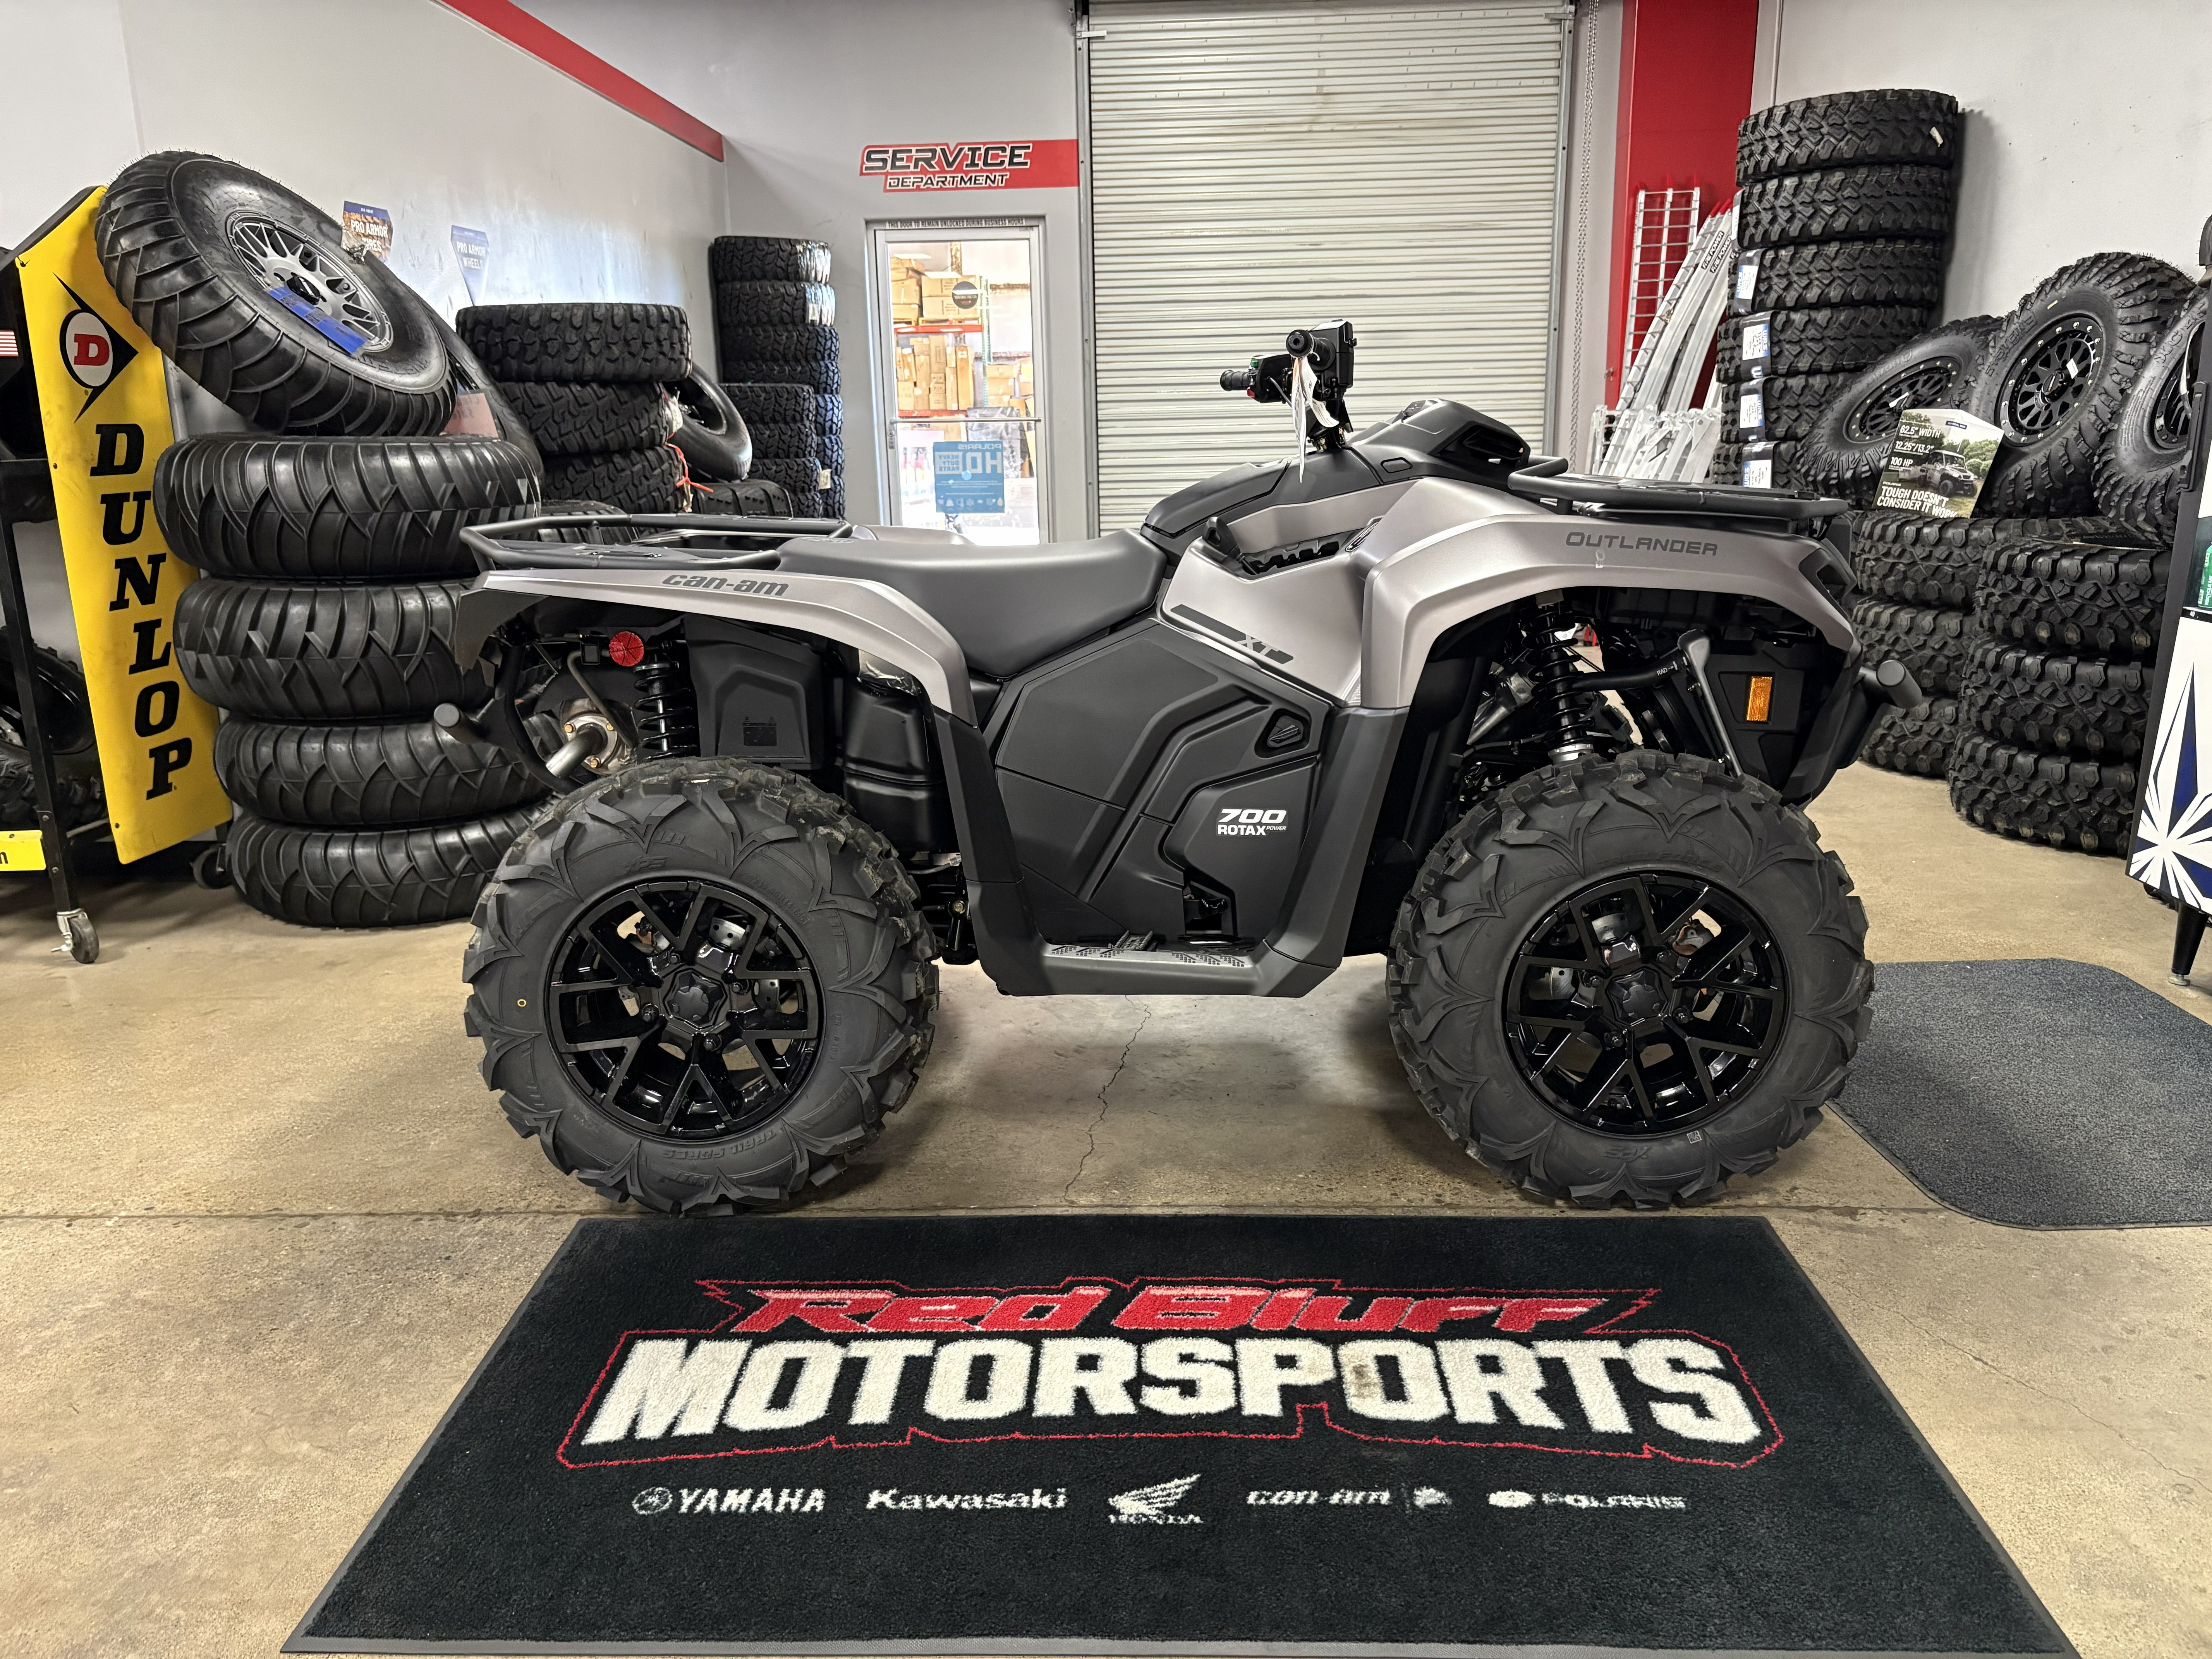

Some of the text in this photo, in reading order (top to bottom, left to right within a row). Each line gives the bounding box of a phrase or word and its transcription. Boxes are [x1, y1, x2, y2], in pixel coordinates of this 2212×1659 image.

[863, 144, 1032, 173] SERVICE
[887, 173, 1009, 189] DEPARTMENT
[350, 220, 388, 238] PRO ARMOR
[457, 241, 467, 253] PRO
[1709, 231, 1724, 255] POWER
[462, 256, 483, 269] WHEELS
[74, 333, 110, 366] D
[1900, 425, 1918, 434] 62.5"
[1919, 428, 1941, 438] WIDTH
[1895, 441, 1934, 453] 12.25"/13.2"
[1891, 457, 1913, 467] 100 HP
[1877, 496, 1922, 510] CONSIDER
[1921, 501, 1932, 513] IT
[1881, 486, 1949, 507] TOUGH DOESN'T
[1566, 532, 1718, 556] OUTLANDER
[662, 575, 789, 596] can-am
[90, 424, 192, 800] DUNLOP
[1236, 634, 1279, 656] XT
[1218, 809, 1287, 824] 700
[1218, 824, 1266, 836] ROTAX
[728, 1285, 1609, 1333] Red Bluff
[581, 1337, 1762, 1446] MOTORSPORTS
[678, 1487, 826, 1513] YAMAHA
[866, 1487, 1070, 1510] Kawasaki
